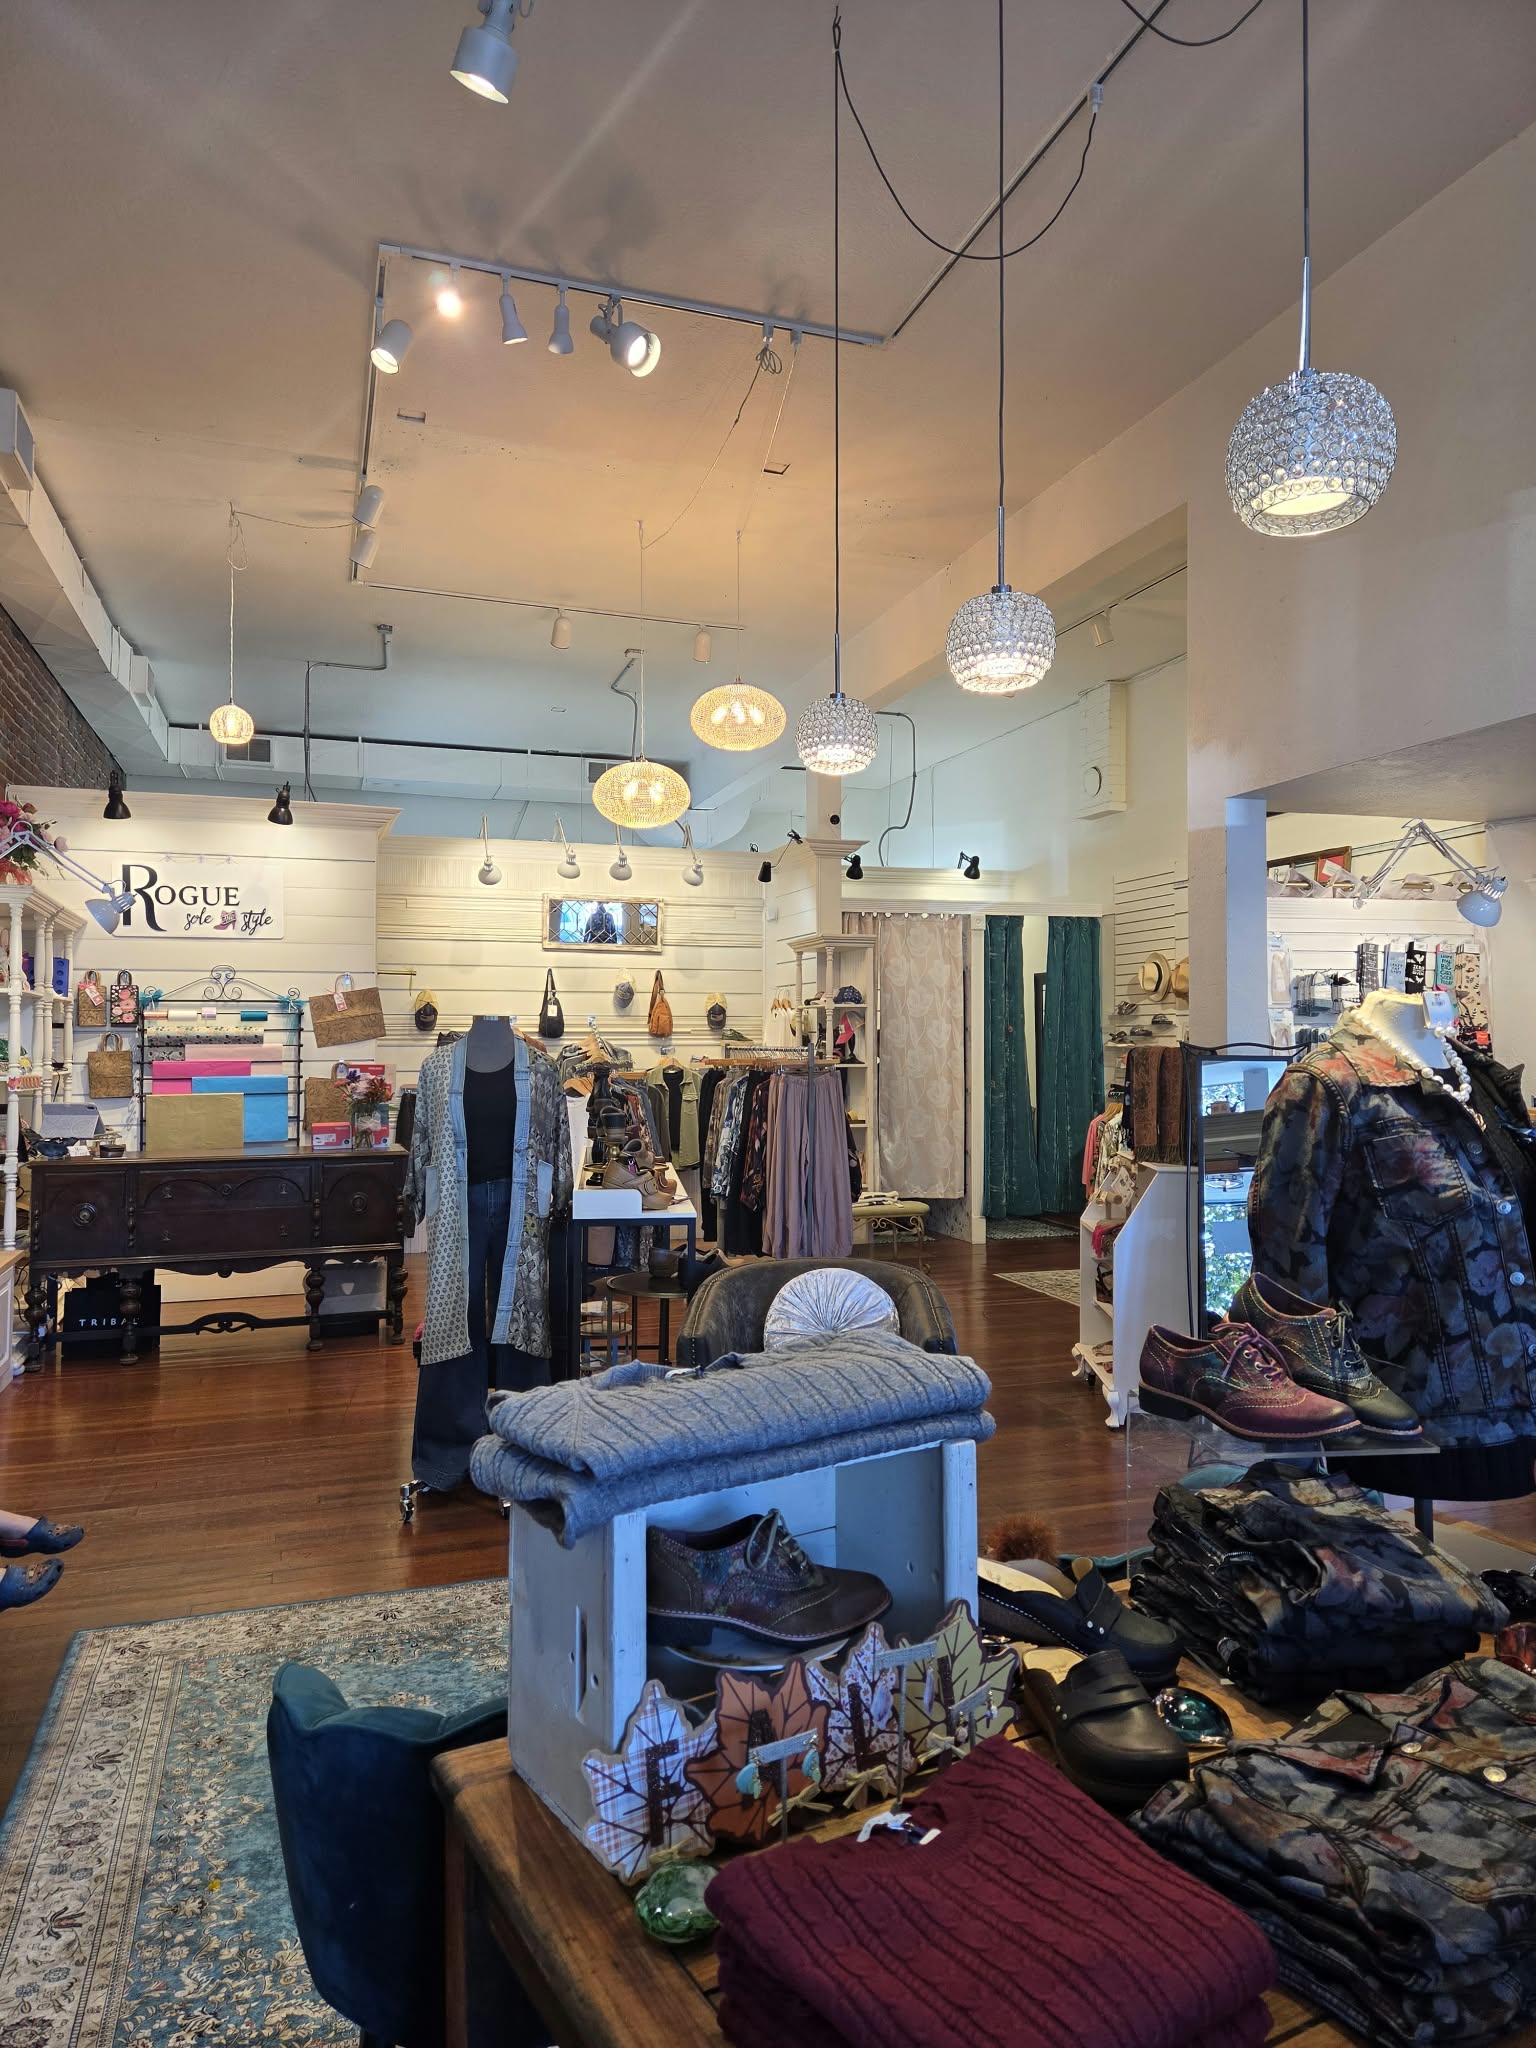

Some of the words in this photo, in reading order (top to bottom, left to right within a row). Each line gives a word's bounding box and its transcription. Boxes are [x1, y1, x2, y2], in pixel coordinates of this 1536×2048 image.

[122, 864, 240, 932] ROGUE
[184, 907, 213, 931] sole
[240, 908, 273, 935] style
